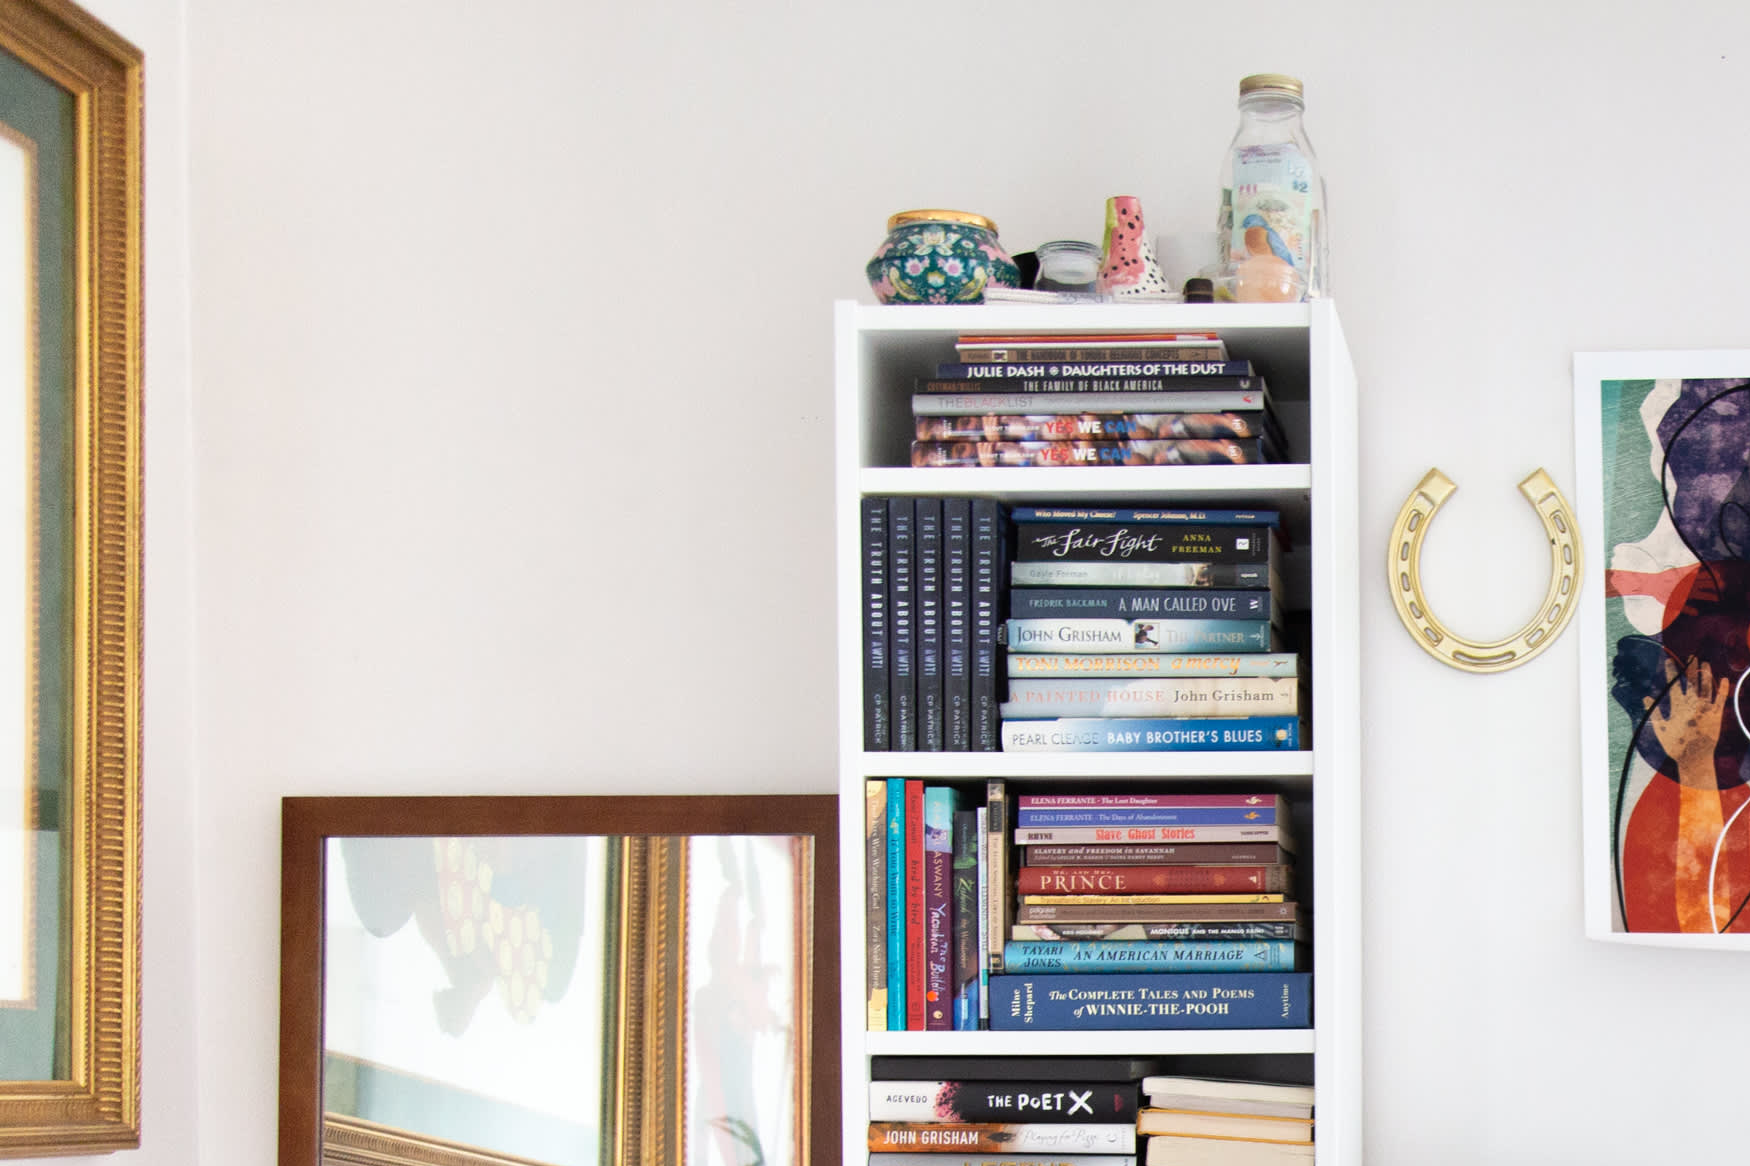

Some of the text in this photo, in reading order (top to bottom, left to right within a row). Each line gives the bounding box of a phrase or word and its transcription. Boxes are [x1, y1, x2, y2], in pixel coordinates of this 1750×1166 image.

[967, 363, 1226, 378] JULIE DASH DAUGHTERS OF THE DUST
[1024, 380, 1163, 392] THE FAMILY OF BLACK AMERICA
[1046, 420, 1137, 434] YES WE CAN
[1041, 448, 1132, 461] YES WE CAN
[1032, 528, 1164, 557] The Fair Fight
[1183, 534, 1211, 542] ANNA
[871, 509, 883, 669] THE TRUTH ABOUT AWITI
[1118, 597, 1237, 611] A MAN CALLED OVE
[1017, 626, 1122, 643] JOHN GRISHAM
[1015, 657, 1160, 672] TONI MORRISON
[1171, 657, 1241, 675] a mercy
[1011, 690, 1165, 703] A PAINTED HOUSE
[1174, 690, 1274, 703] John Grisham
[1012, 732, 1100, 746] PEARL CLEAGE
[1106, 730, 1263, 745] BABY BROTHER'S BLUES
[1095, 828, 1195, 840] Slave Ghost Stories
[1040, 875, 1126, 892] PRINCE
[1022, 946, 1064, 955] TAYARI
[1073, 950, 1244, 961] AN AMERICAN MARRIAGE
[1024, 958, 1062, 968] JONES
[1049, 990, 1067, 1000] The
[1183, 989, 1208, 999] AND
[1281, 984, 1291, 1019] Anytime
[1011, 988, 1021, 1017] Milne
[1024, 982, 1036, 1023] Shepard
[1073, 1003, 1229, 1018] of WINNIE-THE-POOH
[886, 1095, 928, 1104] ACEVEDO
[987, 1095, 1012, 1108] THE
[1067, 1090, 1094, 1115] X
[883, 1131, 979, 1145] JOHN GRISHAM
